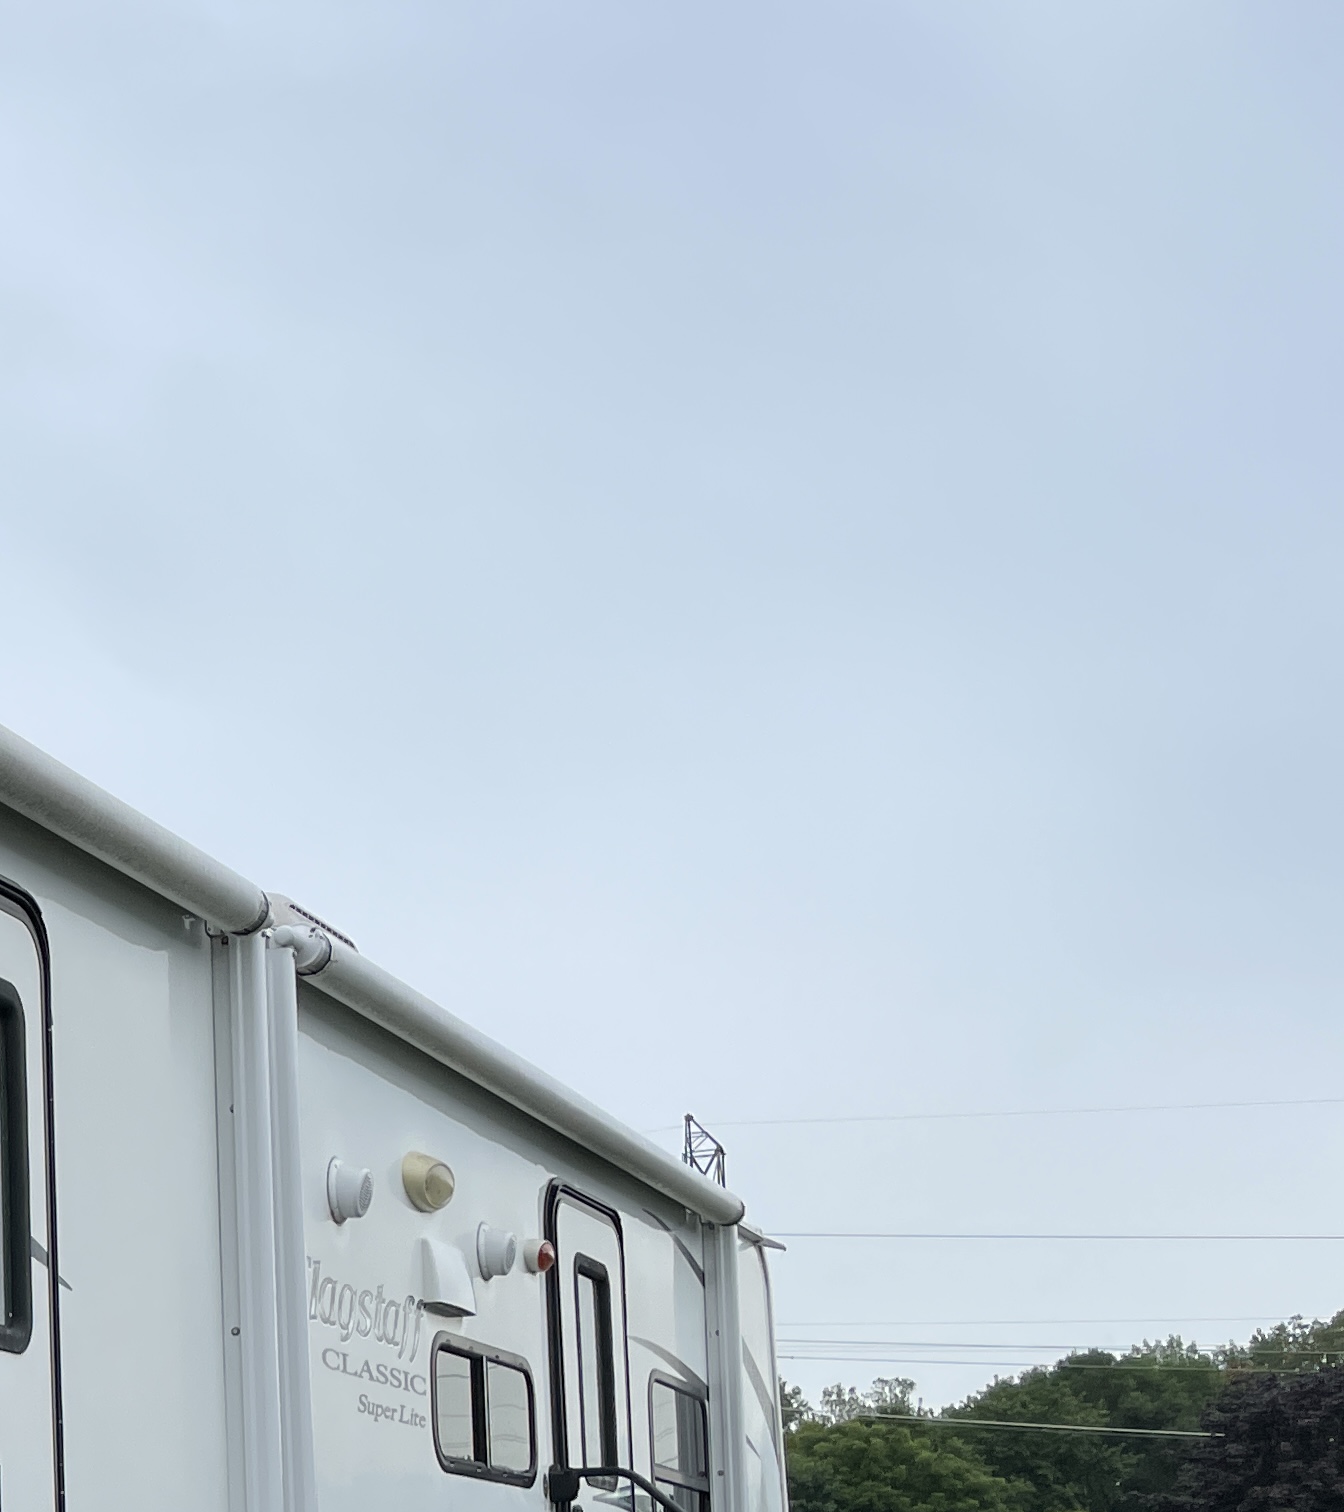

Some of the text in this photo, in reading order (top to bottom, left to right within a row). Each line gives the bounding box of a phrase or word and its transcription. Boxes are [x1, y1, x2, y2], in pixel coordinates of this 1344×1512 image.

[307, 1256, 424, 1363] lagstaff
[322, 1348, 427, 1397] CLASSIC
[357, 1394, 427, 1428] Super Lite
